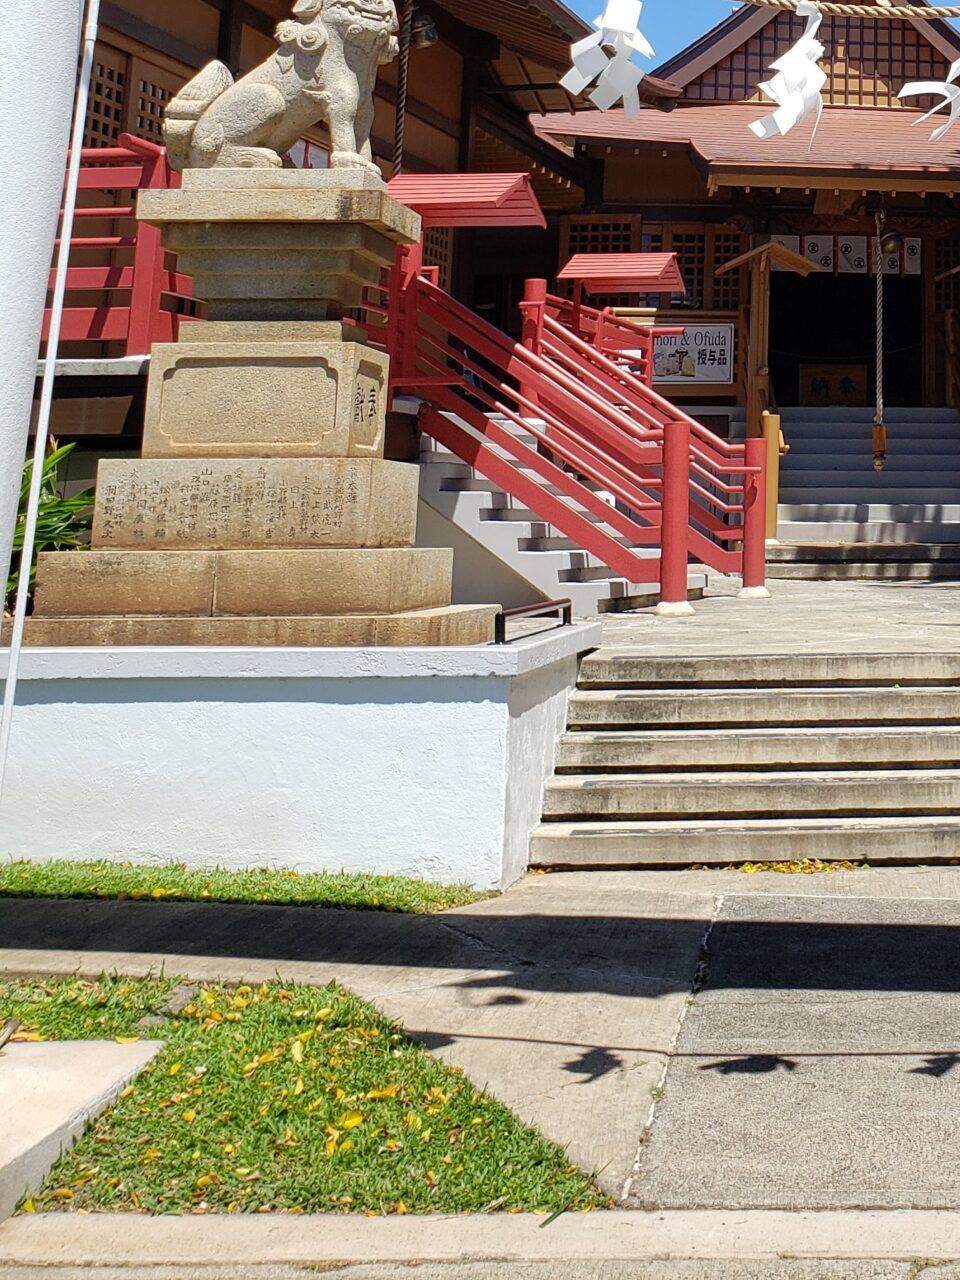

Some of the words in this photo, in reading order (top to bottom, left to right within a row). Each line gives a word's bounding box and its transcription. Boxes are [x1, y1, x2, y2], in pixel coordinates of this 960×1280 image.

[681, 331, 690, 346] &
[694, 331, 727, 346] Ofuda
[697, 348, 727, 366] 授与品
